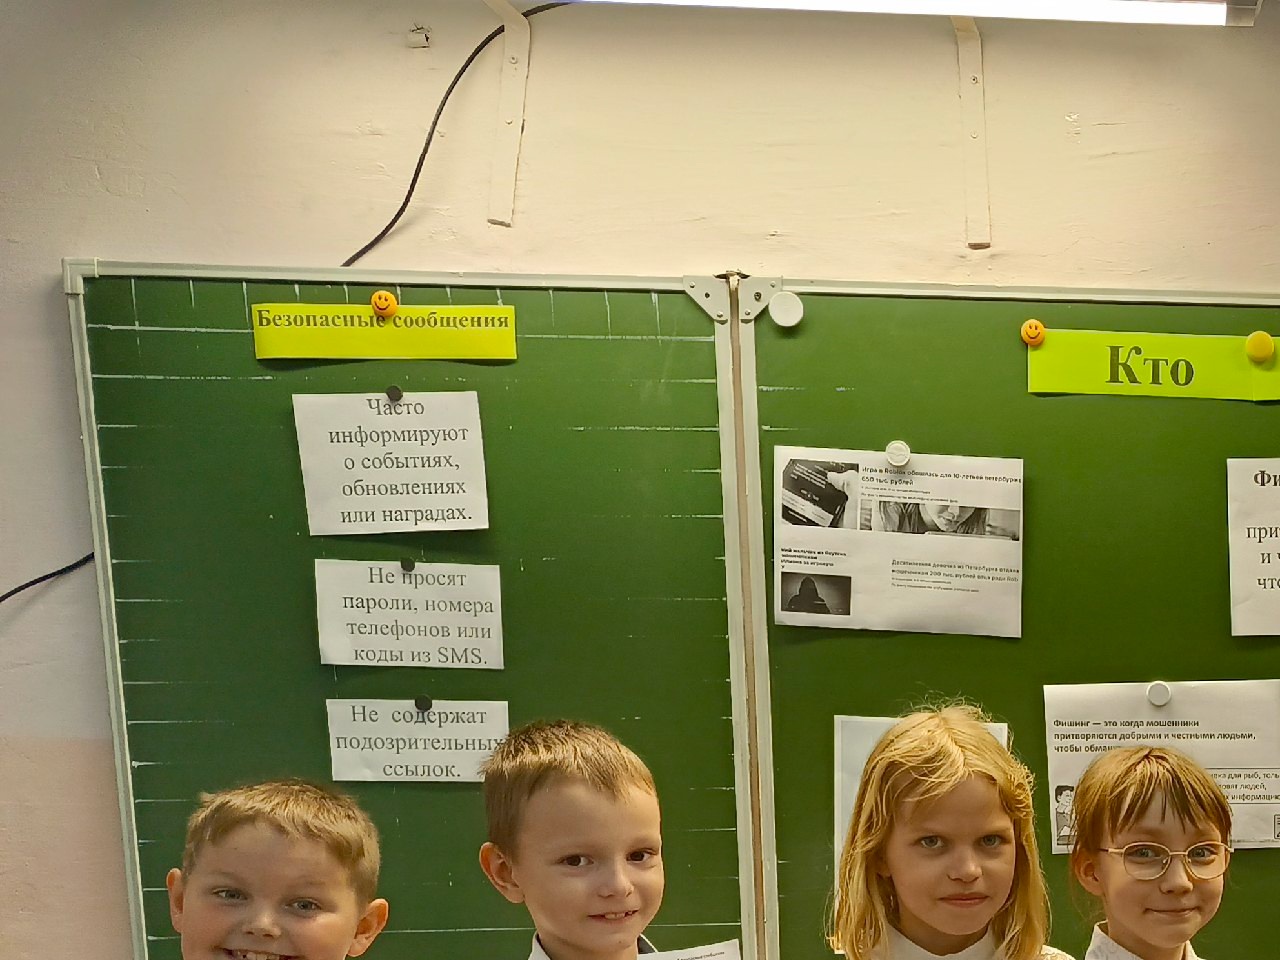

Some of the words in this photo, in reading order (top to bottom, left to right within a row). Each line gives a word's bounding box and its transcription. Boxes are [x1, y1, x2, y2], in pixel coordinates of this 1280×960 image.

[256, 308, 386, 329] Безопасные
[392, 311, 510, 330] сообщения
[1104, 344, 1195, 388] Кто
[366, 397, 425, 416] Часто
[328, 425, 469, 447] информируют
[344, 457, 355, 470] о
[361, 452, 460, 471] событиях,
[342, 479, 466, 497] обновлениях
[340, 510, 376, 523] или
[382, 507, 472, 526] наградах.
[1260, 552, 1271, 564] и
[368, 566, 395, 584] Не
[402, 571, 467, 589] просят
[342, 595, 418, 614] пароли,
[425, 600, 494, 617] номера
[346, 620, 450, 640] телефонов
[457, 626, 492, 639] или
[354, 648, 404, 663] коды
[411, 651, 431, 663] из
[437, 646, 488, 665] SMS.
[351, 705, 379, 722] Не
[391, 709, 487, 728] содержат
[1053, 719, 1091, 728] Фишинг
[1104, 720, 1118, 728] это
[1120, 720, 1145, 729] когда
[1146, 719, 1200, 728] мошенники
[336, 735, 503, 754] подозрительных
[1054, 732, 1118, 742] притворяются
[1119, 730, 1162, 741] добрыми
[1171, 732, 1216, 740] честными
[1217, 732, 1257, 741] людьми,
[1054, 743, 1082, 753] чтобы
[383, 763, 461, 778] ссылок.
